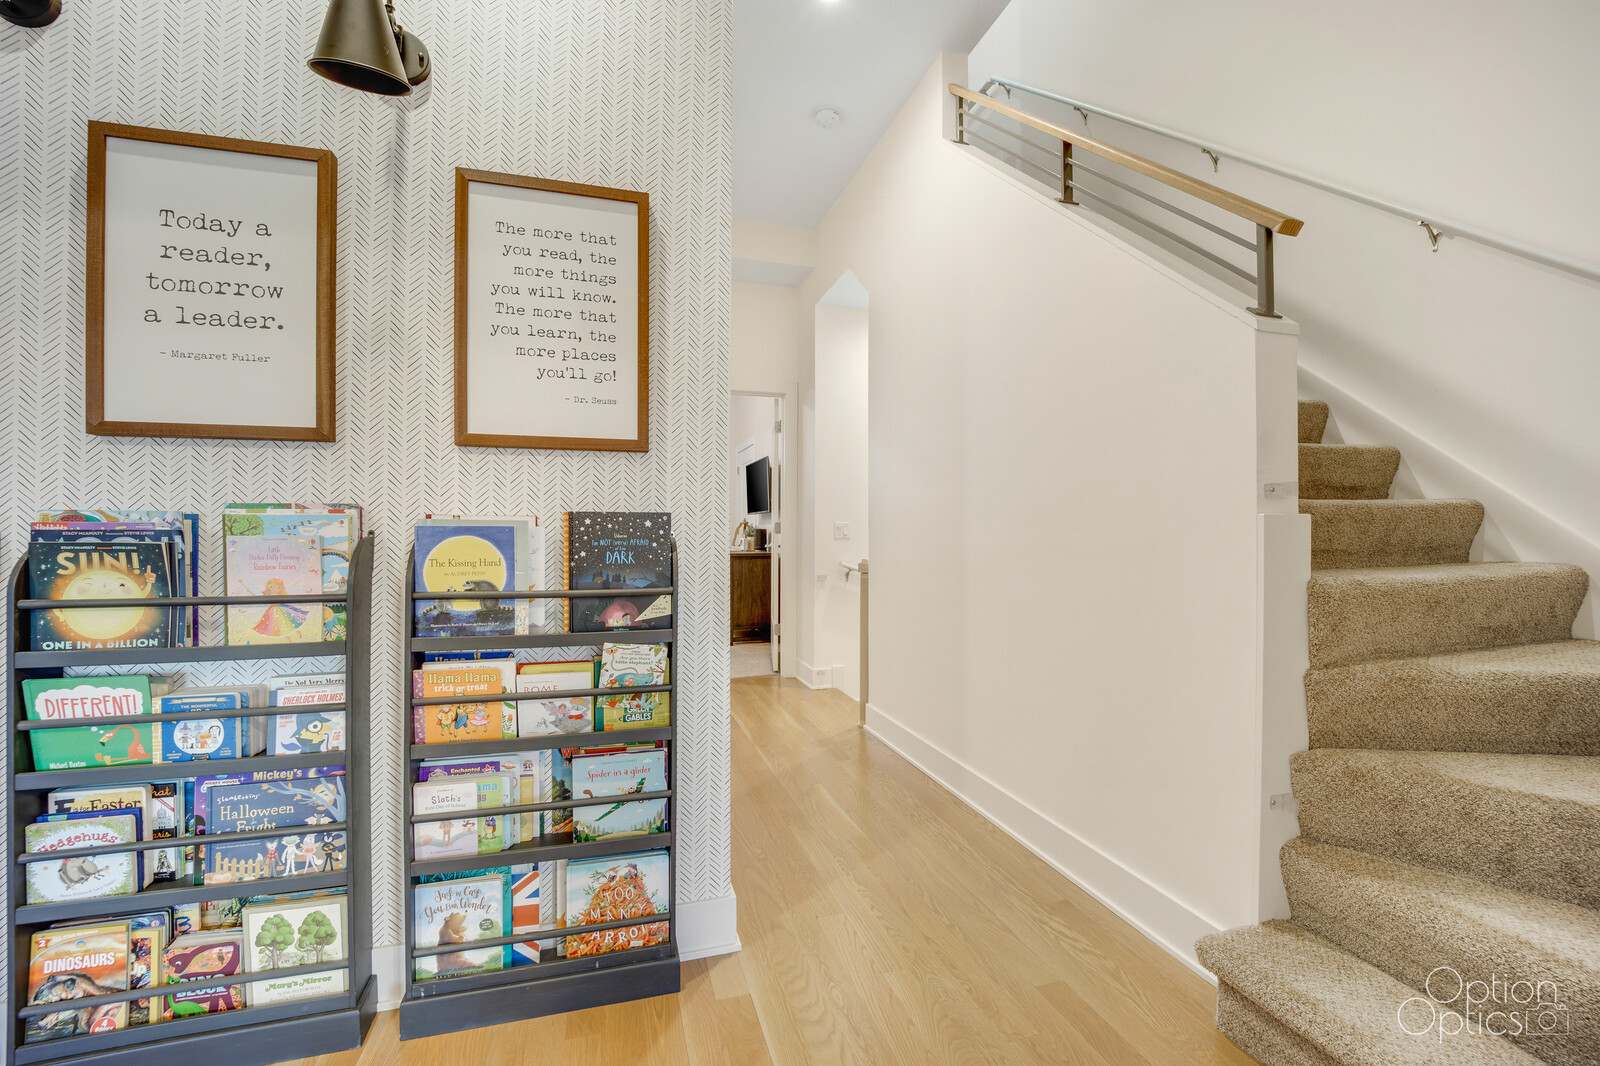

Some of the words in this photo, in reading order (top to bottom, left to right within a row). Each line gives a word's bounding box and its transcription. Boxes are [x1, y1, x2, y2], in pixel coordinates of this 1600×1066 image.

[159, 209, 243, 238] Today
[255, 223, 272, 237] a
[495, 220, 526, 236] The
[533, 227, 573, 242] more
[579, 231, 617, 246] that
[160, 245, 271, 272] reader,
[502, 244, 532, 258] you
[539, 248, 583, 265] read,
[589, 251, 617, 266] the
[513, 265, 554, 279] more
[561, 268, 617, 287] things
[146, 272, 284, 299] tomorrow
[490, 283, 521, 297] you
[527, 286, 566, 300] will
[572, 288, 617, 304] know.
[144, 308, 162, 323] a
[175, 306, 284, 330] leader.
[494, 301, 526, 316] The
[532, 307, 573, 320] more
[579, 309, 617, 324] that
[490, 323, 520, 337] you
[527, 324, 583, 343] learn,
[589, 329, 617, 344] the
[171, 350, 228, 361] Margaret
[231, 352, 271, 363] Fuller
[515, 346, 556, 359] more
[561, 348, 617, 362] places
[536, 367, 588, 380] you'll
[593, 370, 617, 384] go!
[573, 396, 588, 404] Dr.
[591, 396, 617, 406] Seuss
[629, 538, 650, 547] AFRAID
[56, 551, 141, 576] SUN!
[428, 558, 446, 568] The
[448, 558, 478, 569] Kissing
[479, 557, 502, 568] Hand
[605, 550, 636, 565] DARK
[42, 640, 73, 650] ONE
[76, 640, 92, 650] IN
[95, 640, 103, 649] A
[106, 638, 159, 649] BILLION
[428, 672, 462, 685] llama
[464, 671, 497, 684] llama
[434, 684, 455, 693] trick
[466, 683, 489, 692] treat
[523, 685, 558, 693] ROME
[44, 694, 138, 720] DIFFERENT!
[282, 694, 317, 706] SHERLOCK
[625, 712, 652, 722] GABLES
[49, 761, 68, 770] Michael
[450, 766, 481, 775] Enchanted
[586, 768, 611, 782] Spider
[613, 768, 623, 777] in
[623, 768, 629, 776] a
[629, 763, 653, 779] glider
[252, 769, 303, 782] Mickey's
[54, 798, 75, 814] E
[90, 797, 142, 812] Easter
[431, 794, 462, 805] Sloth's
[219, 804, 295, 821] Halloween
[152, 831, 172, 839] aris
[434, 886, 455, 903] Just
[463, 885, 483, 899] Case
[603, 886, 635, 904] TOO
[419, 903, 443, 925] You
[455, 896, 498, 915] Wonder
[590, 901, 649, 922] MANY
[38, 939, 48, 948] 2
[42, 951, 116, 975] DINOSAURS
[265, 980, 299, 993] Mary's
[299, 975, 333, 987] Mirror
[101, 1018, 109, 1027] 4
